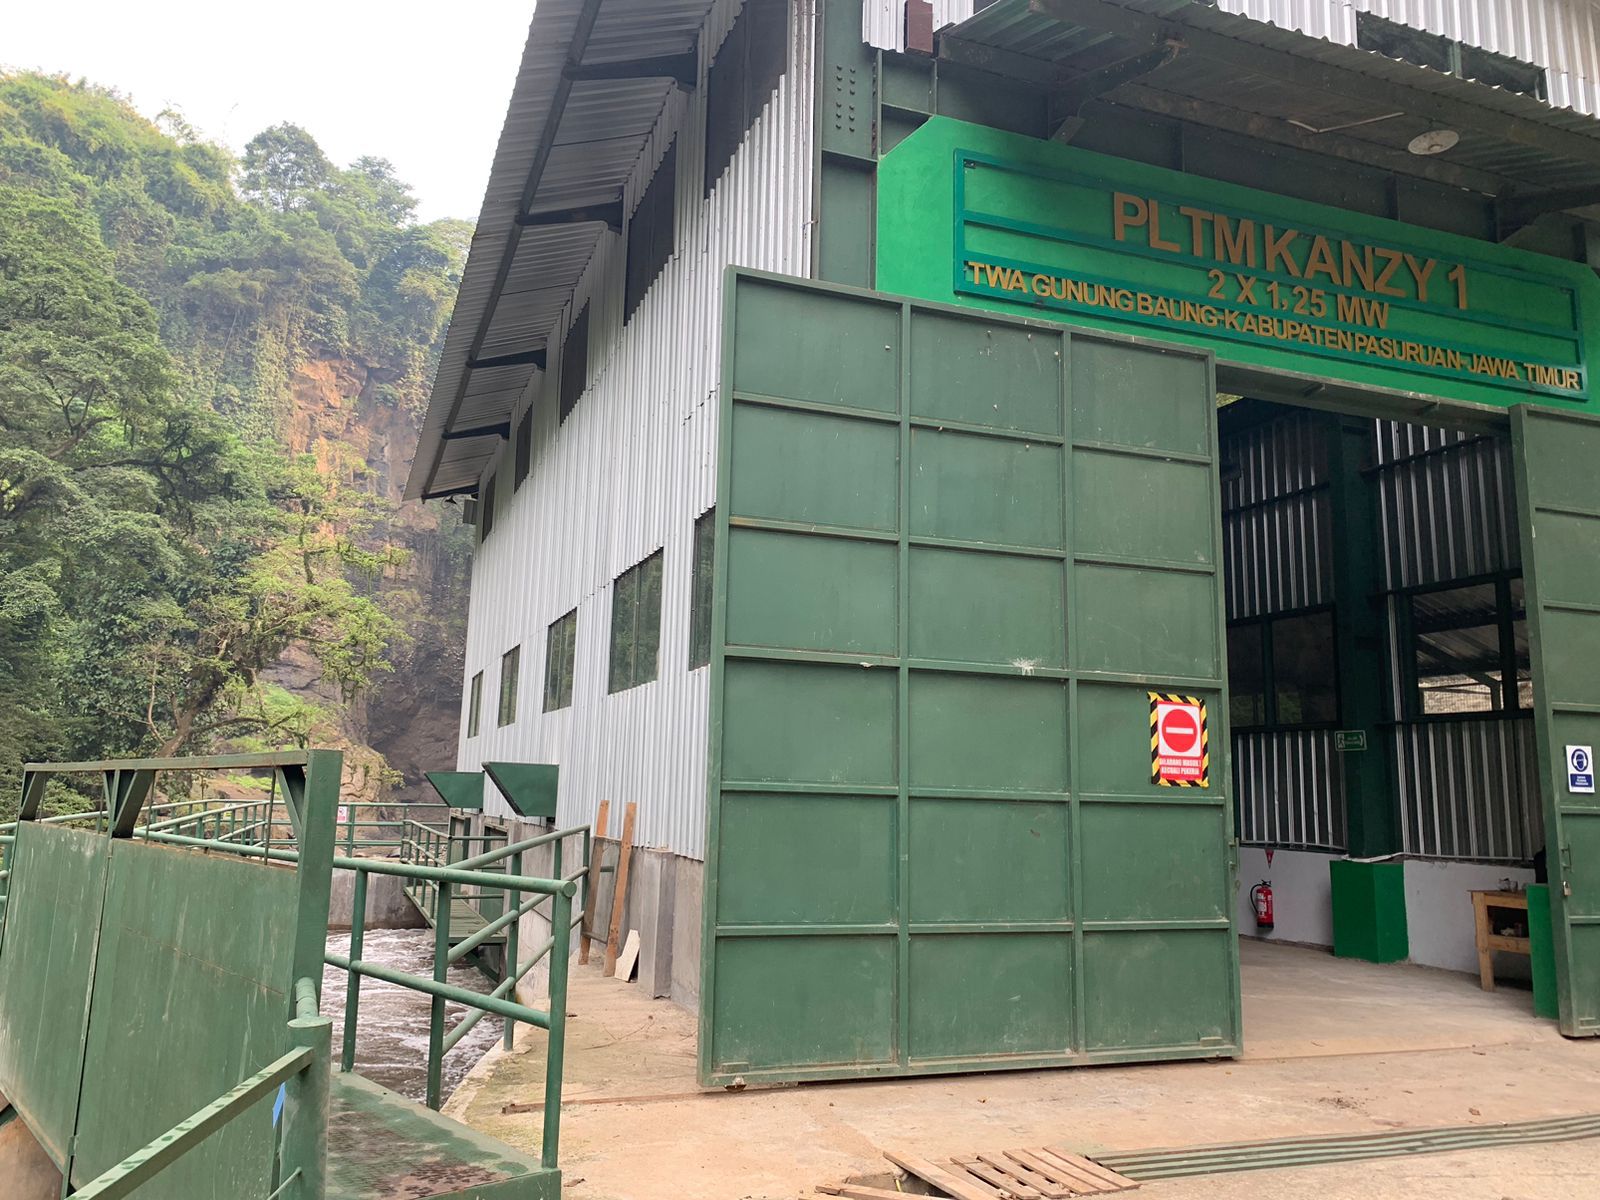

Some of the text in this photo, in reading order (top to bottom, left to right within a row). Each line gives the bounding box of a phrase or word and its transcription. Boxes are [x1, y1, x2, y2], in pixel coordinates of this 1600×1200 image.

[1113, 191, 1468, 310] PLTM KANZY 1
[1206, 269, 1389, 329] 2 X 1,25 MW
[967, 261, 1028, 293] TWA
[1031, 273, 1134, 312] GUNUNG
[1523, 362, 1581, 391] TIMUR
